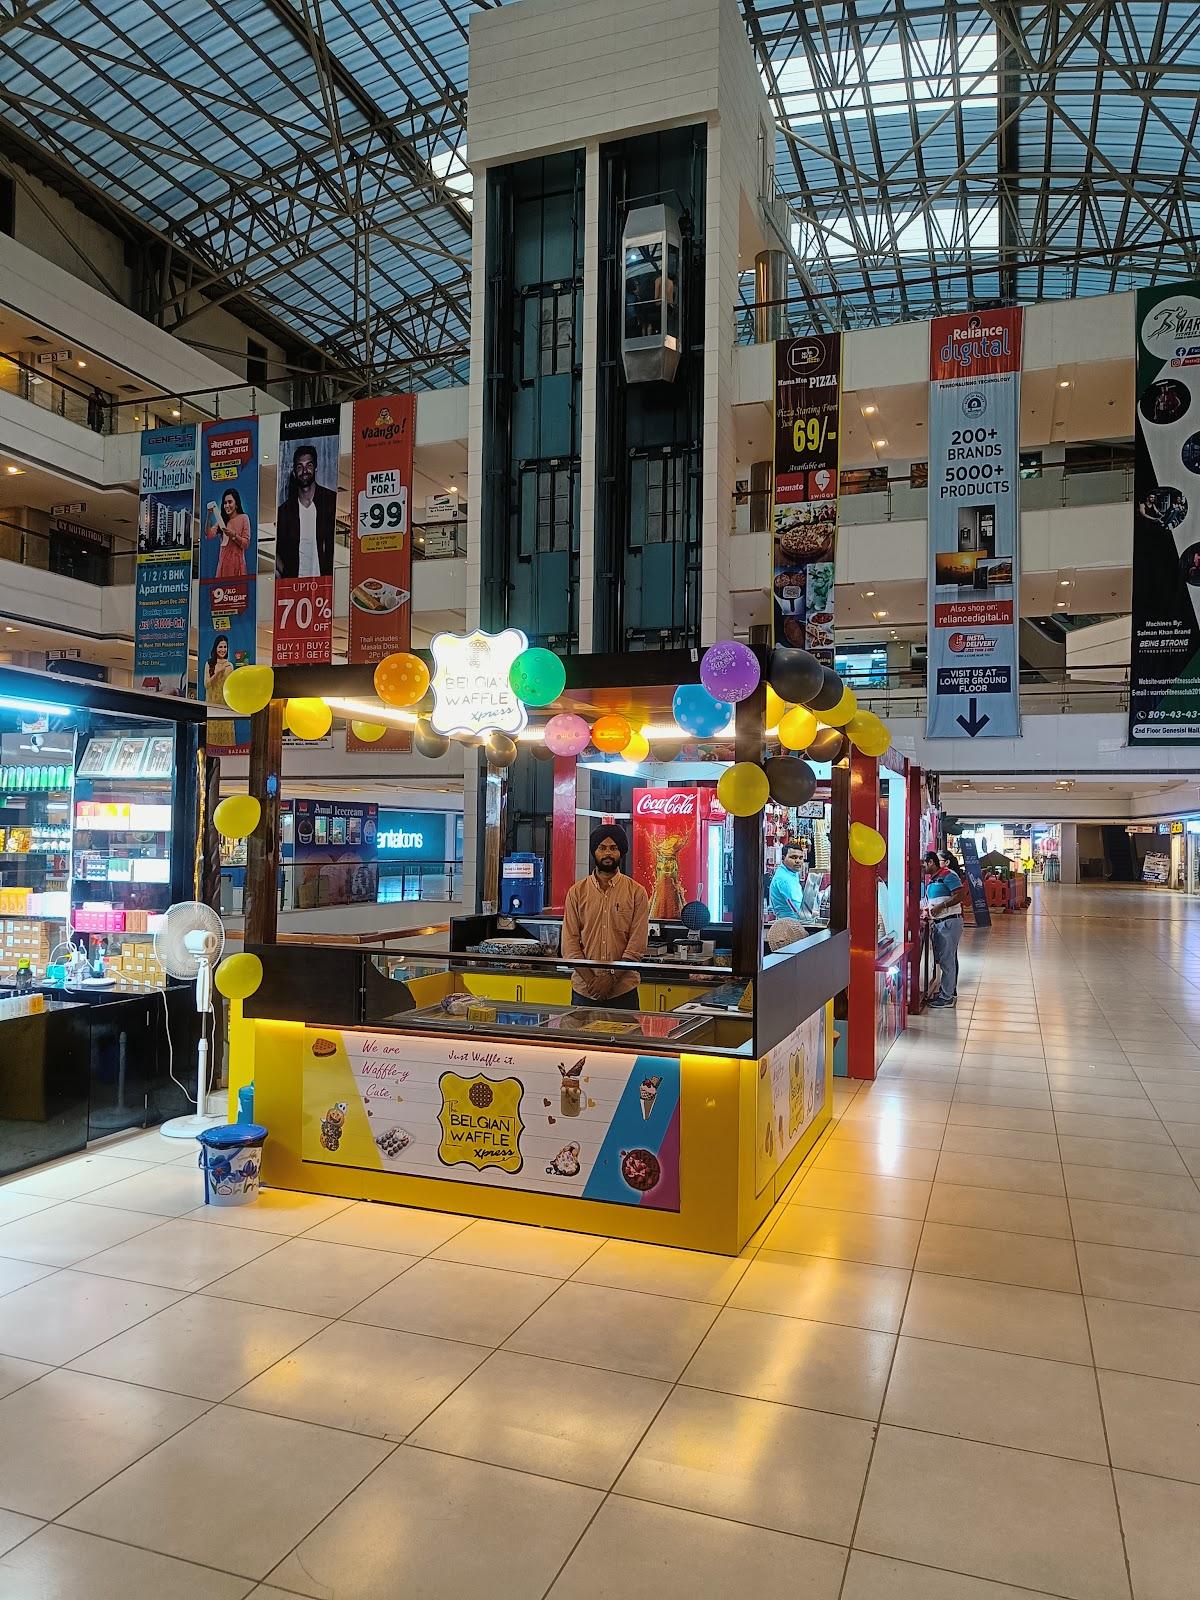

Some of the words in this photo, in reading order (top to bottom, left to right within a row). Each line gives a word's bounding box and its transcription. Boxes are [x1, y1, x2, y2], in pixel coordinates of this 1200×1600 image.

[954, 326, 1003, 340] Reliance
[941, 328, 1011, 366] digital
[809, 374, 838, 388] PIZZA
[978, 377, 1011, 385] TECHNOLOGY
[362, 417, 407, 440] Vaango!
[793, 416, 836, 453] 69/-
[234, 437, 249, 445] कम
[951, 427, 997, 445] 200+
[948, 444, 1002, 460] BRANDS
[370, 472, 396, 483] MEAL
[945, 464, 1004, 482] 5000+
[372, 484, 389, 495] FOR
[391, 484, 395, 493] 1
[777, 484, 804, 492] zomato
[940, 480, 1009, 498] PRODUCTS
[168, 569, 185, 580] BHK
[139, 582, 189, 596] Apartments
[293, 582, 318, 592] UPTO
[223, 594, 247, 603] Sugar
[968, 605, 985, 613] shop
[939, 612, 1009, 623] reliancedigital.in
[277, 643, 293, 651] BUY
[296, 643, 300, 651] 1
[306, 642, 323, 650] BUY
[324, 641, 330, 649] 2
[966, 640, 995, 648] DELIVERY
[1160, 638, 1189, 647] STRONG
[277, 652, 293, 660] GET
[294, 652, 300, 660] 3
[306, 651, 323, 659] GET
[971, 676, 1007, 684] GROUND
[446, 692, 509, 706] WAFFLE
[314, 803, 333, 815] Amul
[334, 805, 364, 817] Icecream
[637, 793, 697, 815] Coca-Cola
[362, 1039, 378, 1054] We
[383, 1045, 400, 1054] are
[448, 1050, 468, 1061] Just
[472, 1051, 501, 1066] Waffle
[450, 1114, 510, 1132] BELGIAN
[451, 1131, 510, 1146] WAFFLE
[474, 1148, 515, 1159] xpress
